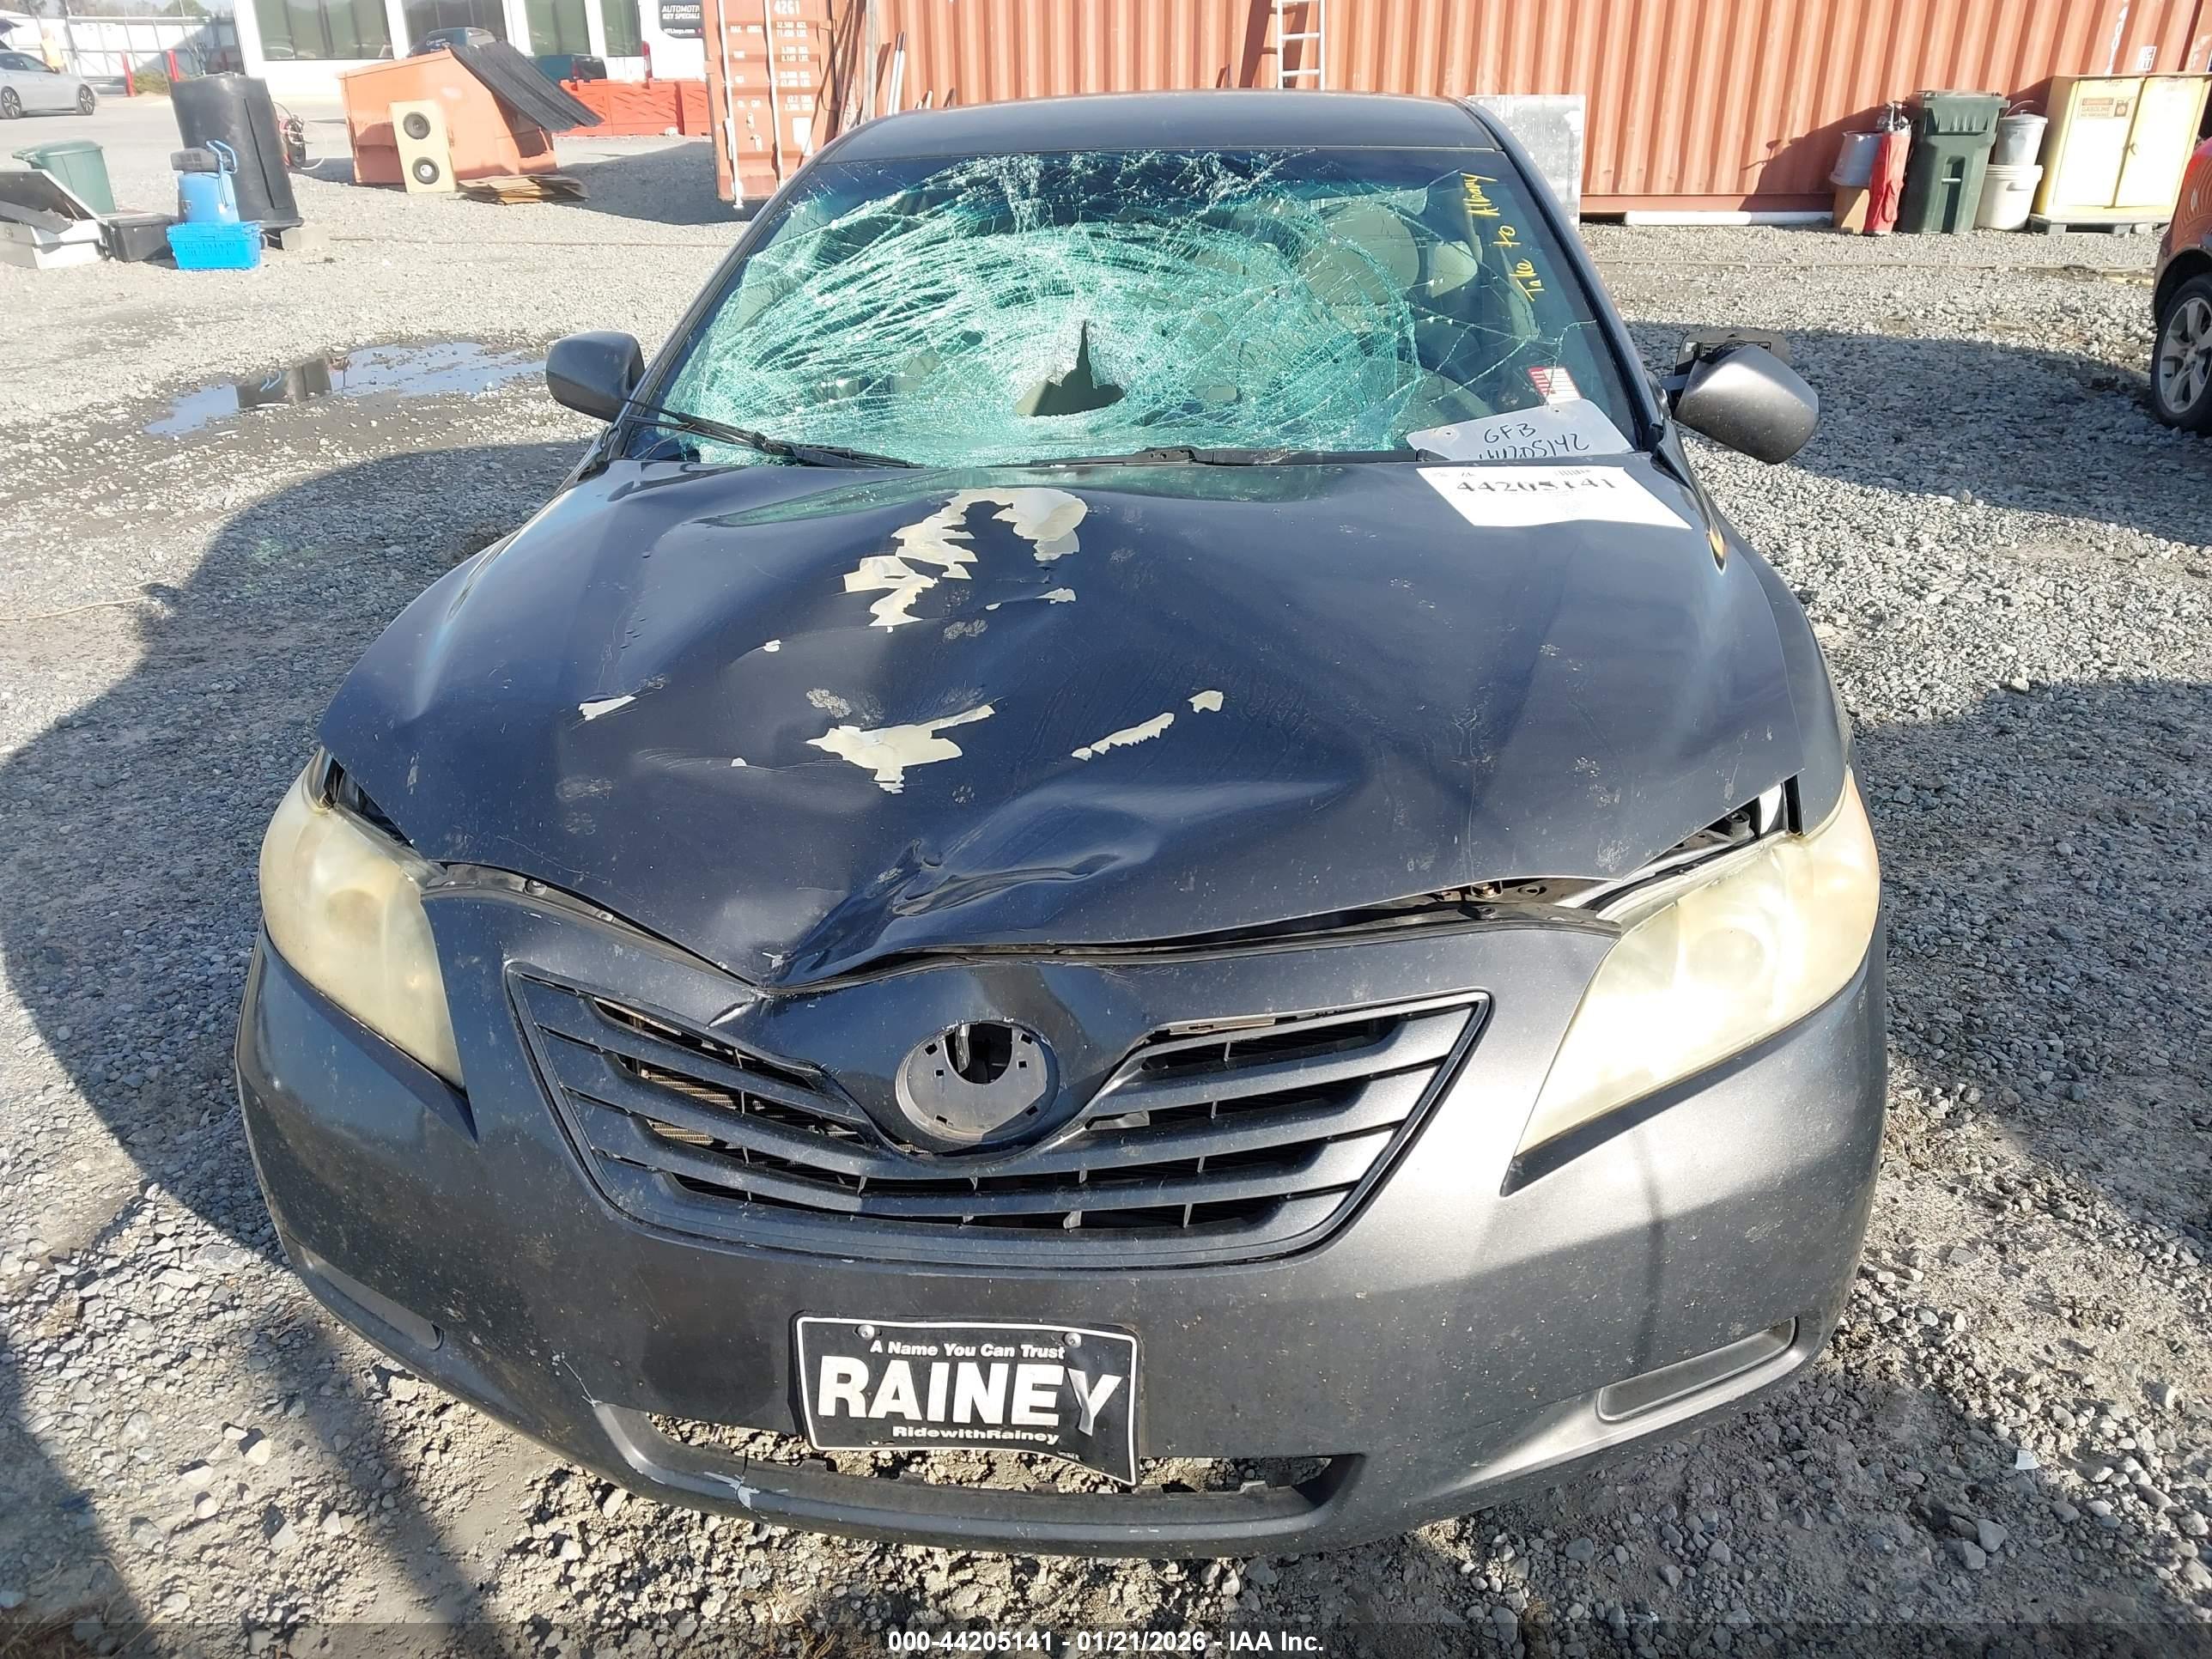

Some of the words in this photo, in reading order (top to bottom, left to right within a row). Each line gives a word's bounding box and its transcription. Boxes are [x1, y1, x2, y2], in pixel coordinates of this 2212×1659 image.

[1461, 173, 1501, 216] Albany
[1492, 224, 1522, 247] to
[1509, 258, 1546, 302] Take
[1457, 477, 1616, 492] 44205141
[870, 1340, 883, 1353] A
[888, 1341, 938, 1357] Name
[944, 1343, 974, 1358] You
[980, 1343, 1014, 1358] Can
[1021, 1344, 1065, 1359] Trust
[817, 1355, 1121, 1437] RAINEY
[892, 1426, 1060, 1443] RidewithRainey
